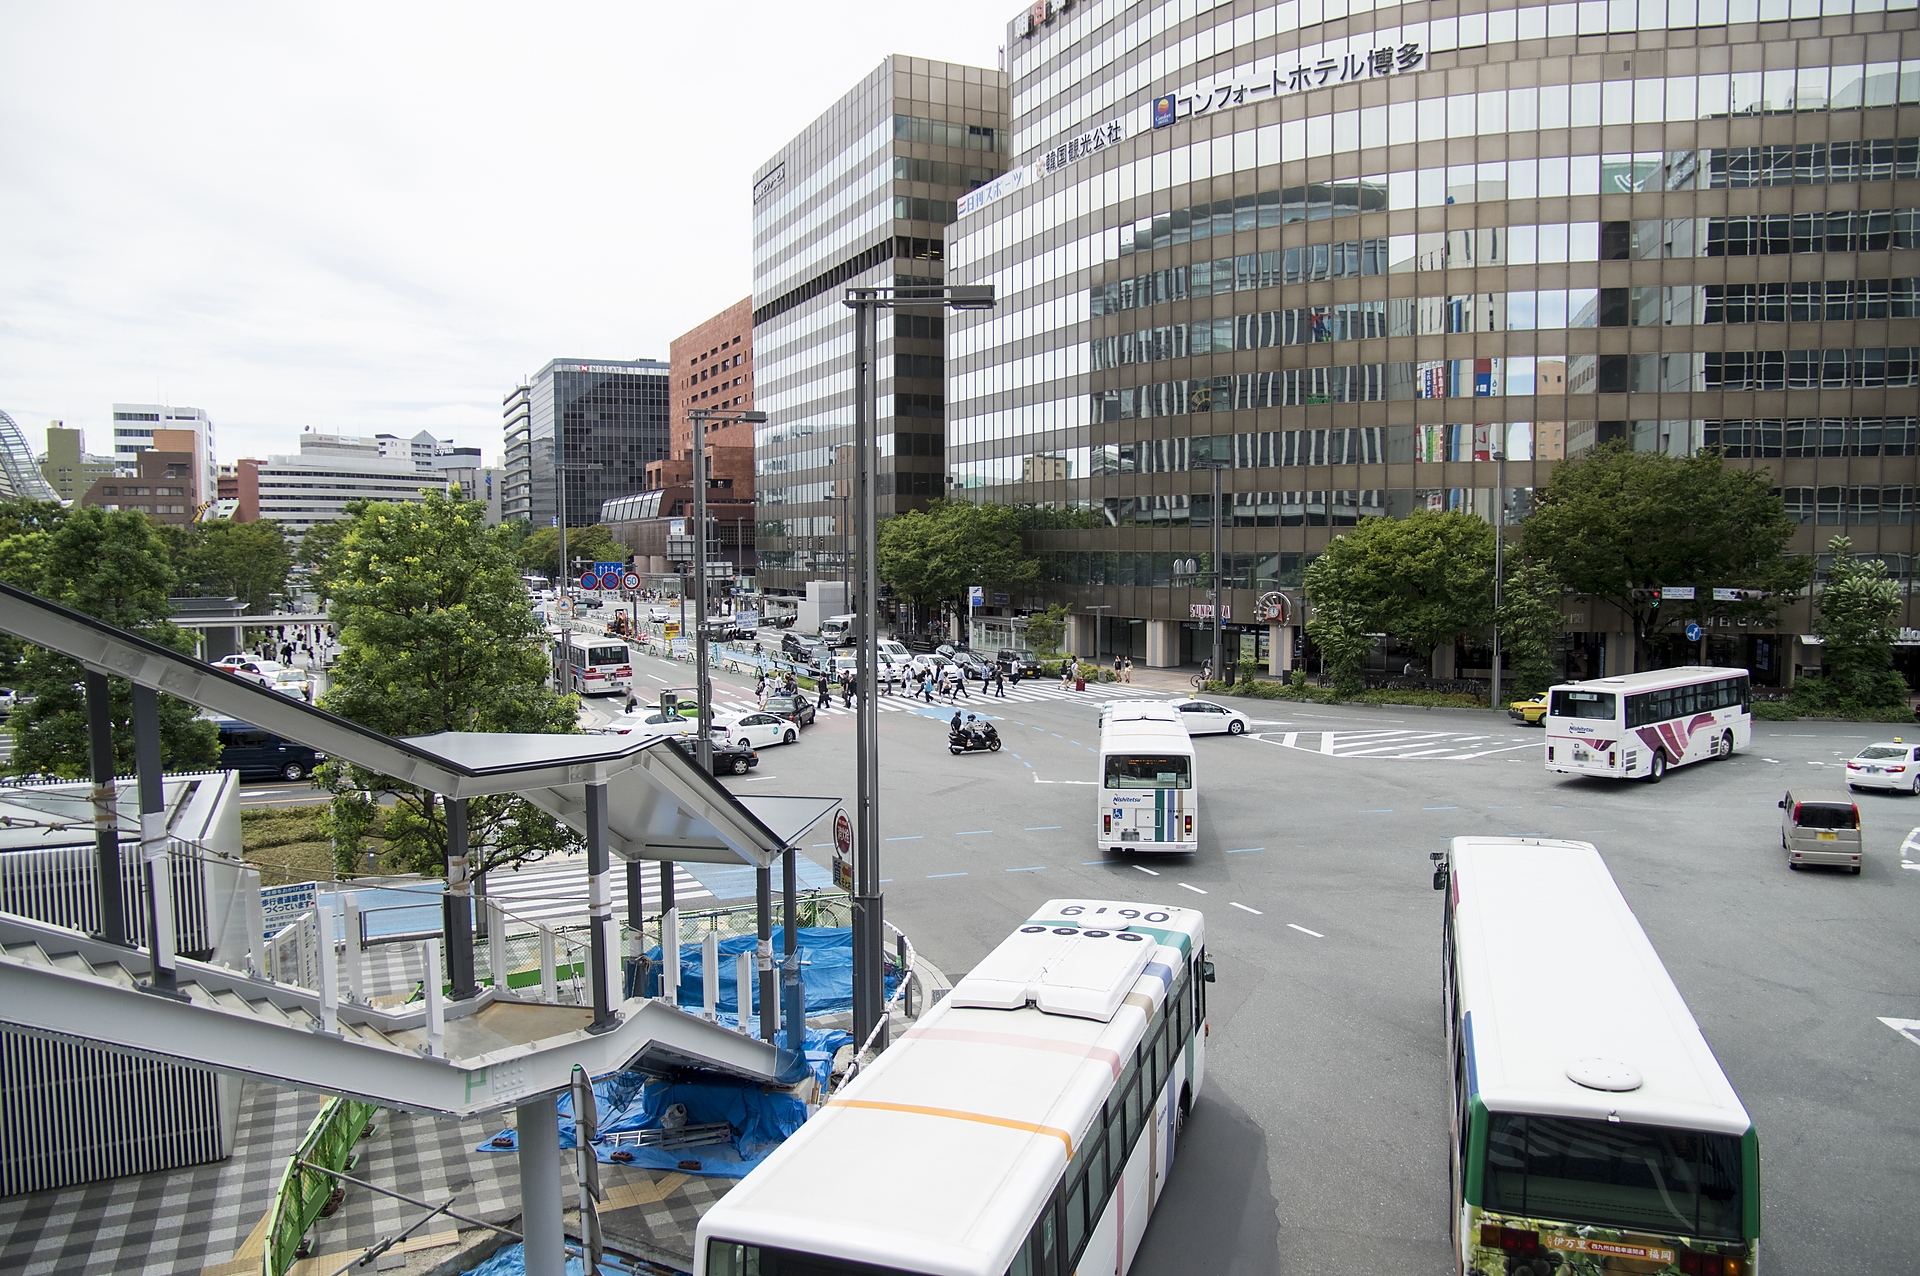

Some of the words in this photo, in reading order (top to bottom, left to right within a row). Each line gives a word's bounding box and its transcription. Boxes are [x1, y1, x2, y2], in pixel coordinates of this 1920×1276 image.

[1178, 43, 1424, 119] コンフォートホテル博多
[1045, 120, 1122, 173] 韓国観光公社
[966, 171, 1023, 213] 日刊スポーツ
[626, 576, 637, 586] 50
[1568, 725, 1595, 733] Nishitetsu
[261, 892, 313, 907] 歩行者連絡橋を
[264, 900, 311, 914] つくっています
[1553, 1236, 1587, 1250] 伊万里
[1648, 1248, 1673, 1261] 福岡
